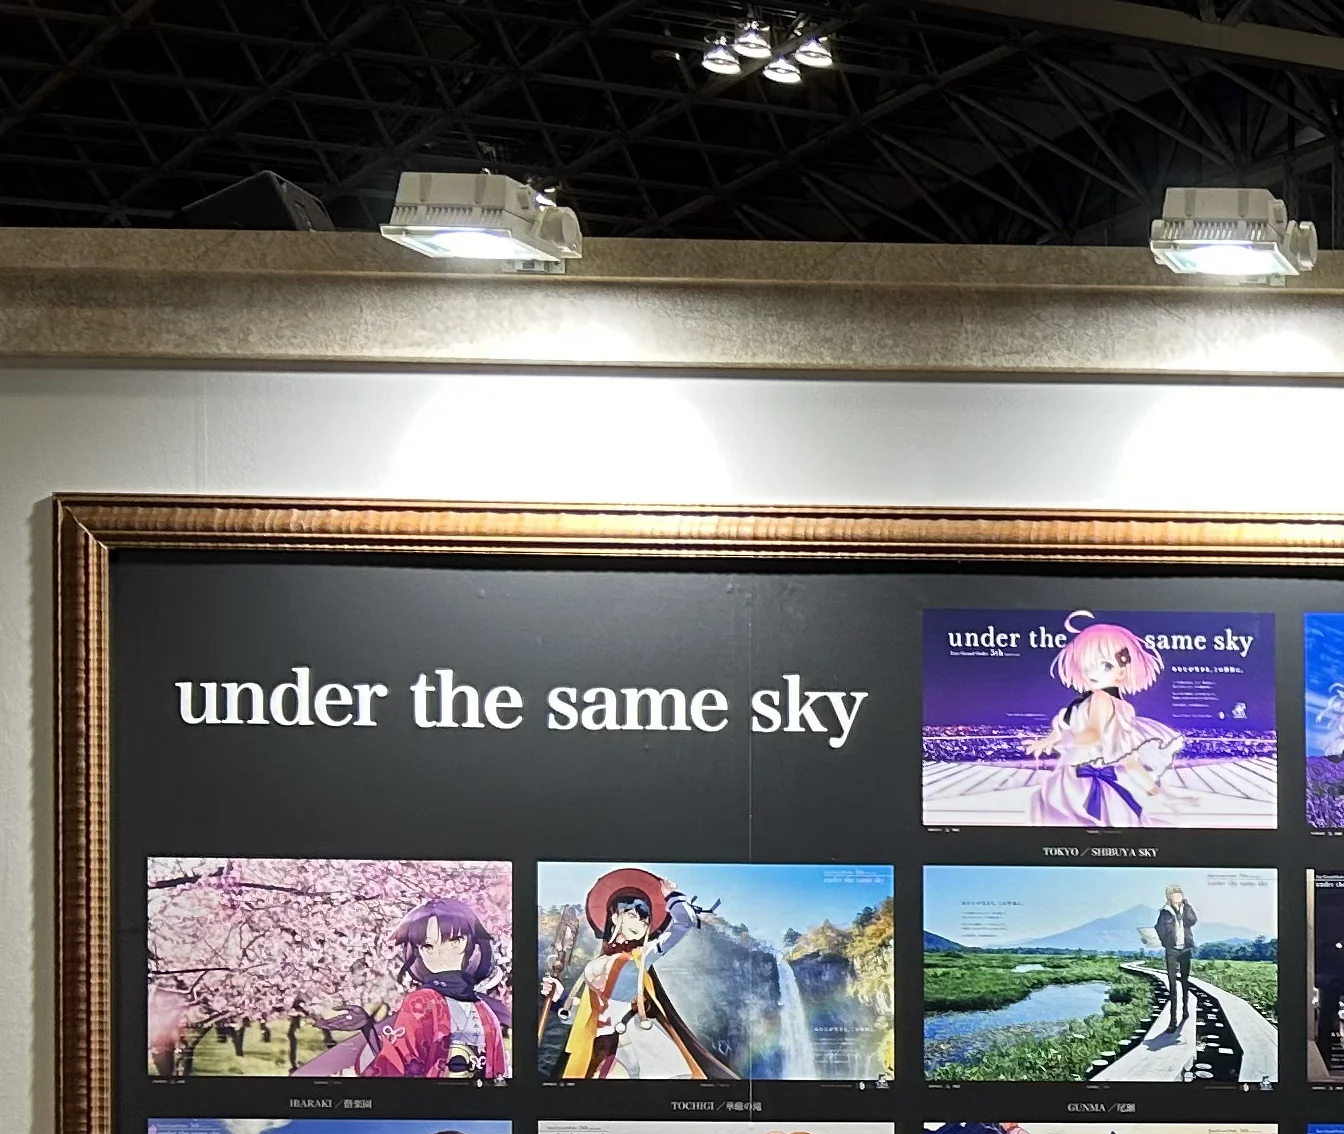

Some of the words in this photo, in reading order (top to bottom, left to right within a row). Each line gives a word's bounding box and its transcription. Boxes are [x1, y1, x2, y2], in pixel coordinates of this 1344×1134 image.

[948, 625, 1022, 649] under
[1029, 625, 1067, 649] the
[1144, 632, 1207, 651] same
[1213, 628, 1255, 657] sky
[174, 667, 388, 728] under
[411, 669, 525, 730] the
[547, 686, 729, 733] same
[750, 674, 869, 748] sky
[1042, 847, 1080, 857] TOKYO
[1091, 847, 1137, 857] SHIBUYA
[1138, 848, 1159, 858] SKY
[289, 1098, 333, 1108] IBARAKI
[670, 1101, 715, 1111] TOCHIGI
[1067, 1103, 1107, 1112] GUNMA
